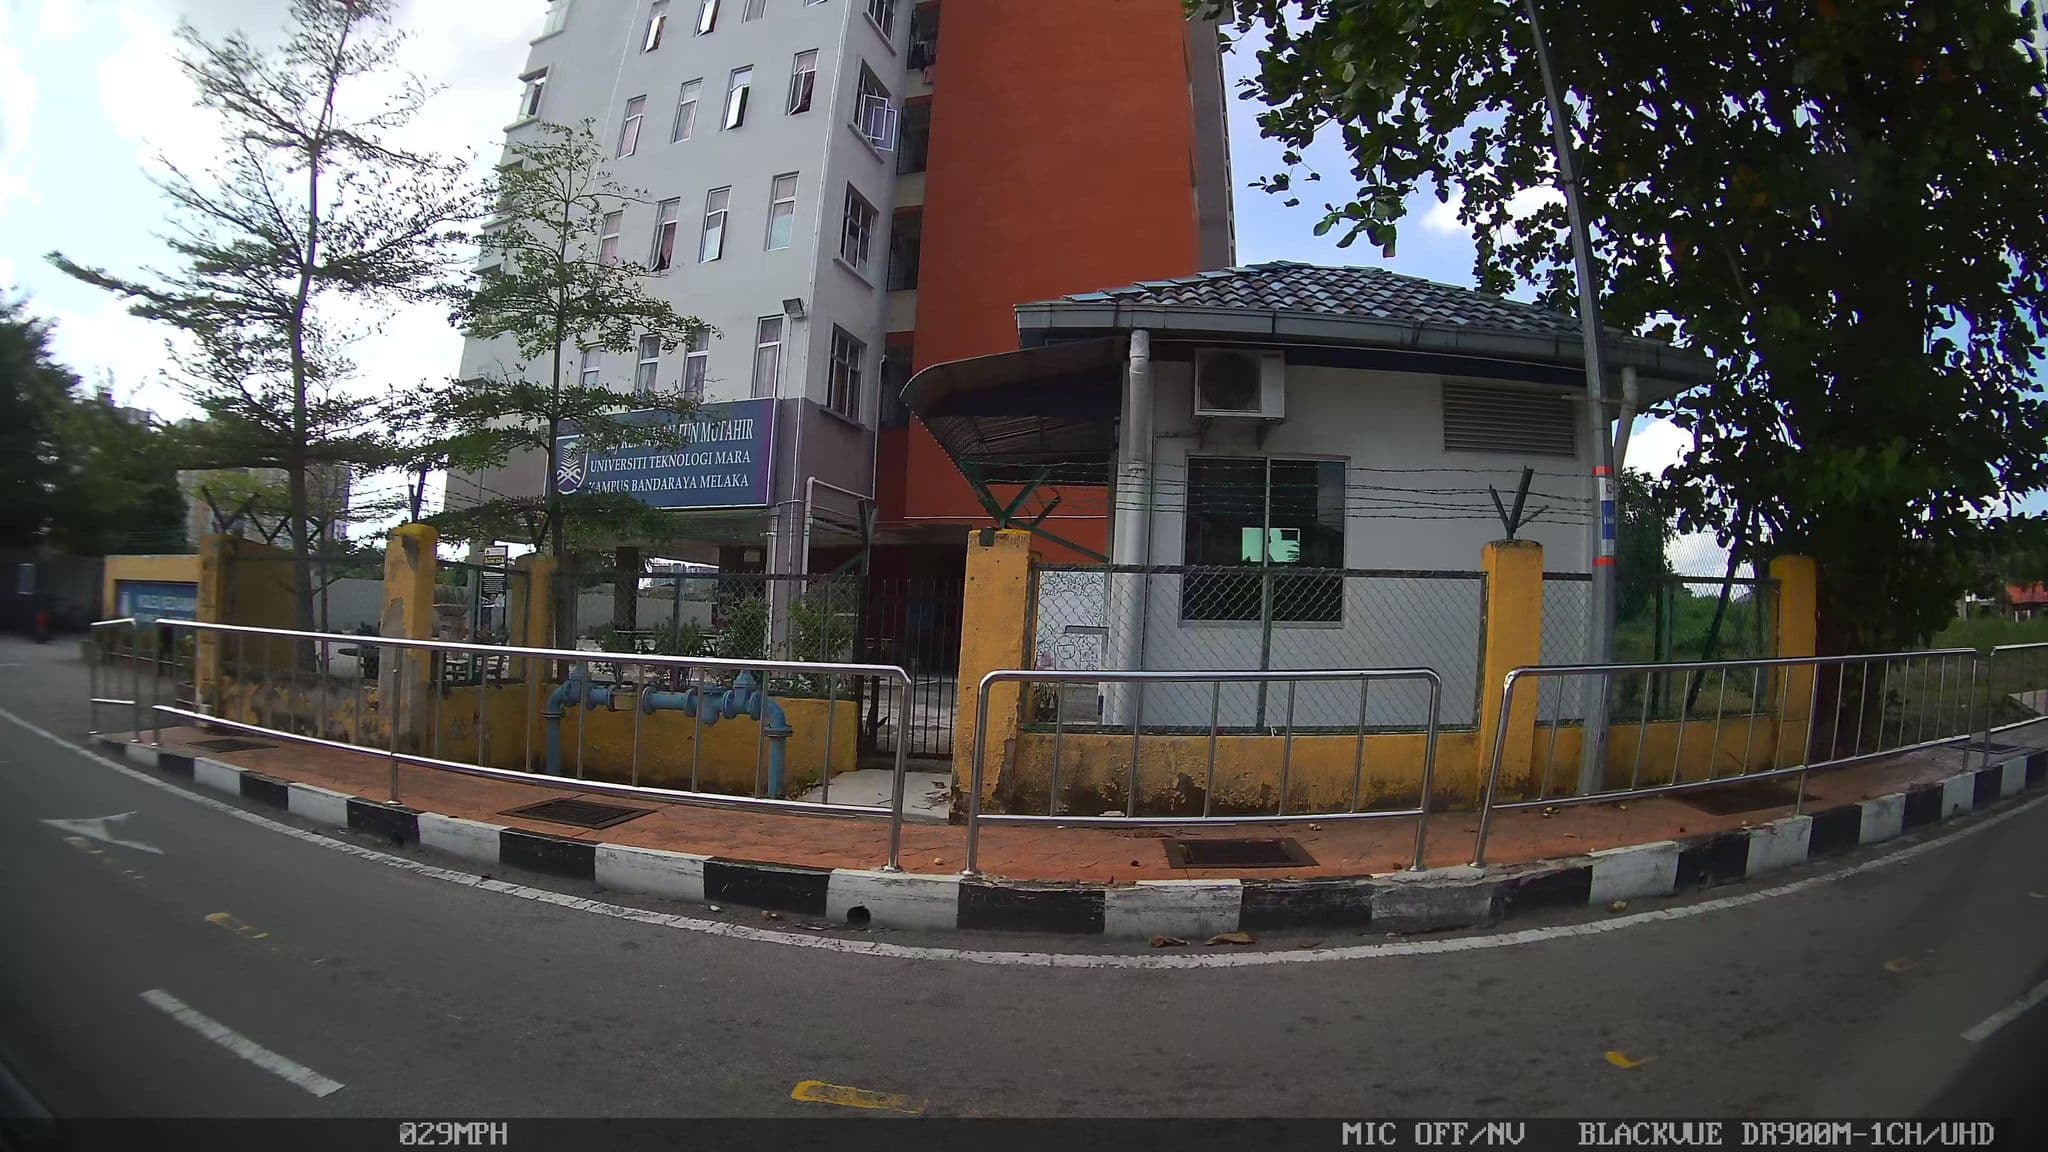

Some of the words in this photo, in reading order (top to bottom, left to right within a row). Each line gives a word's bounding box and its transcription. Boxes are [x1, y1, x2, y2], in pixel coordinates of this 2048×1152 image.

[700, 418, 753, 443] MUTAHIR
[590, 456, 648, 473] UNIVERSITI
[649, 451, 713, 469] TEKNOLOGI
[715, 449, 752, 466] MARA
[631, 476, 697, 493] BANDARAYA
[699, 473, 750, 489] MELAKA
